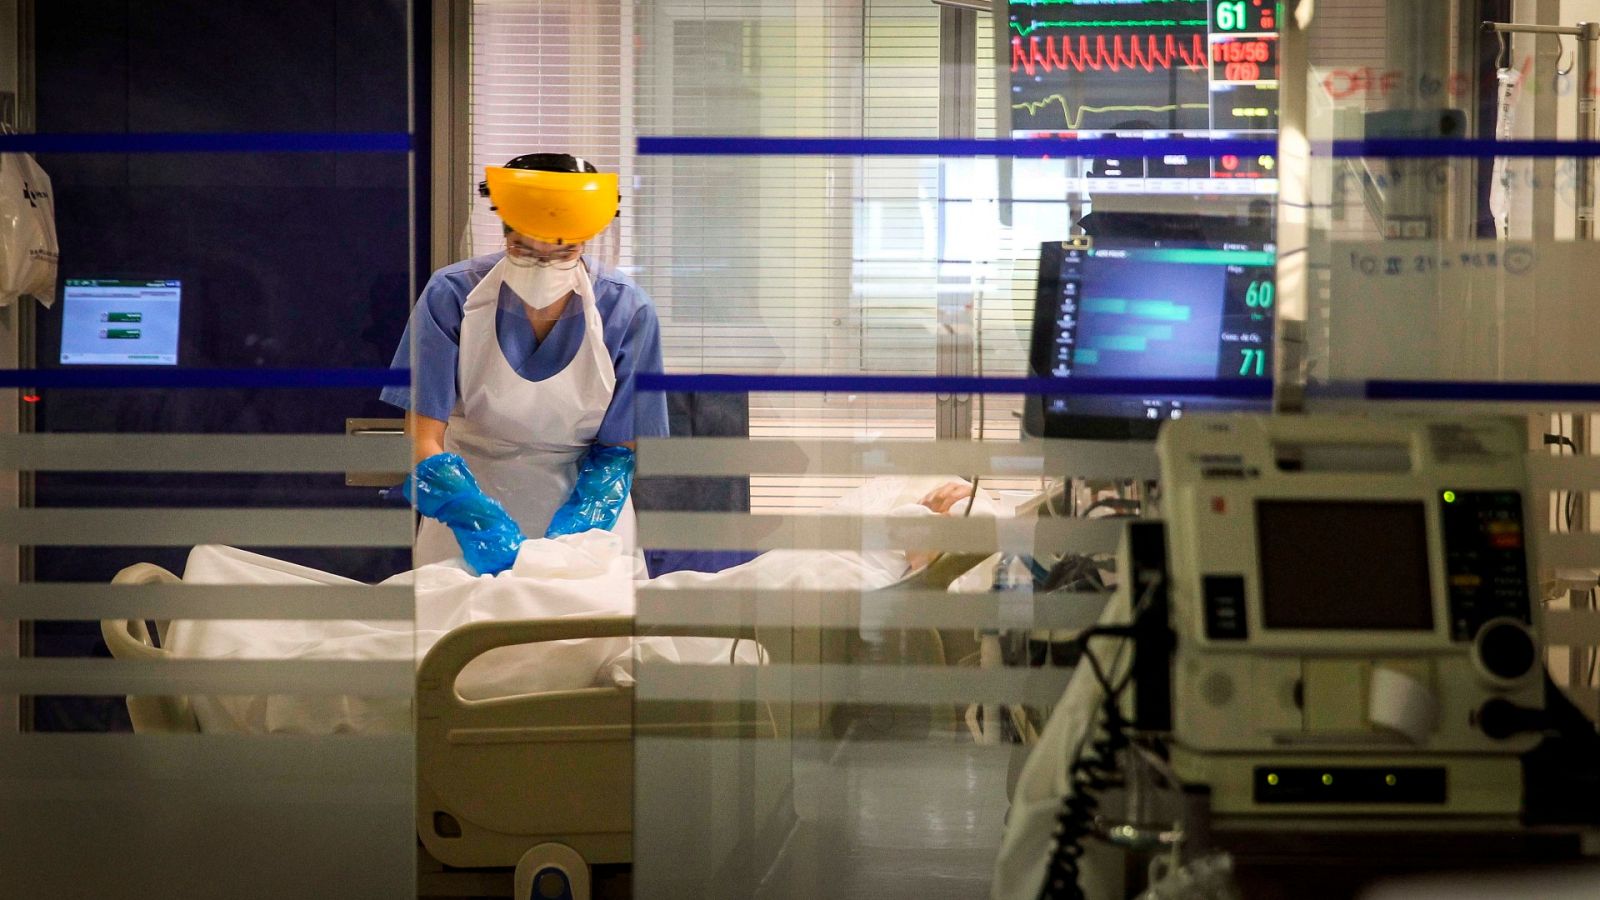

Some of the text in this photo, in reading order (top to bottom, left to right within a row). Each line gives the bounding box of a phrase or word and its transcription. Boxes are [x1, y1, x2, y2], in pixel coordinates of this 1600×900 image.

[1217, 1, 1246, 30] 61
[1213, 41, 1269, 62] 115/56
[1225, 62, 1260, 81] (76)
[1246, 281, 1274, 308] 60
[1239, 349, 1264, 376] 71
